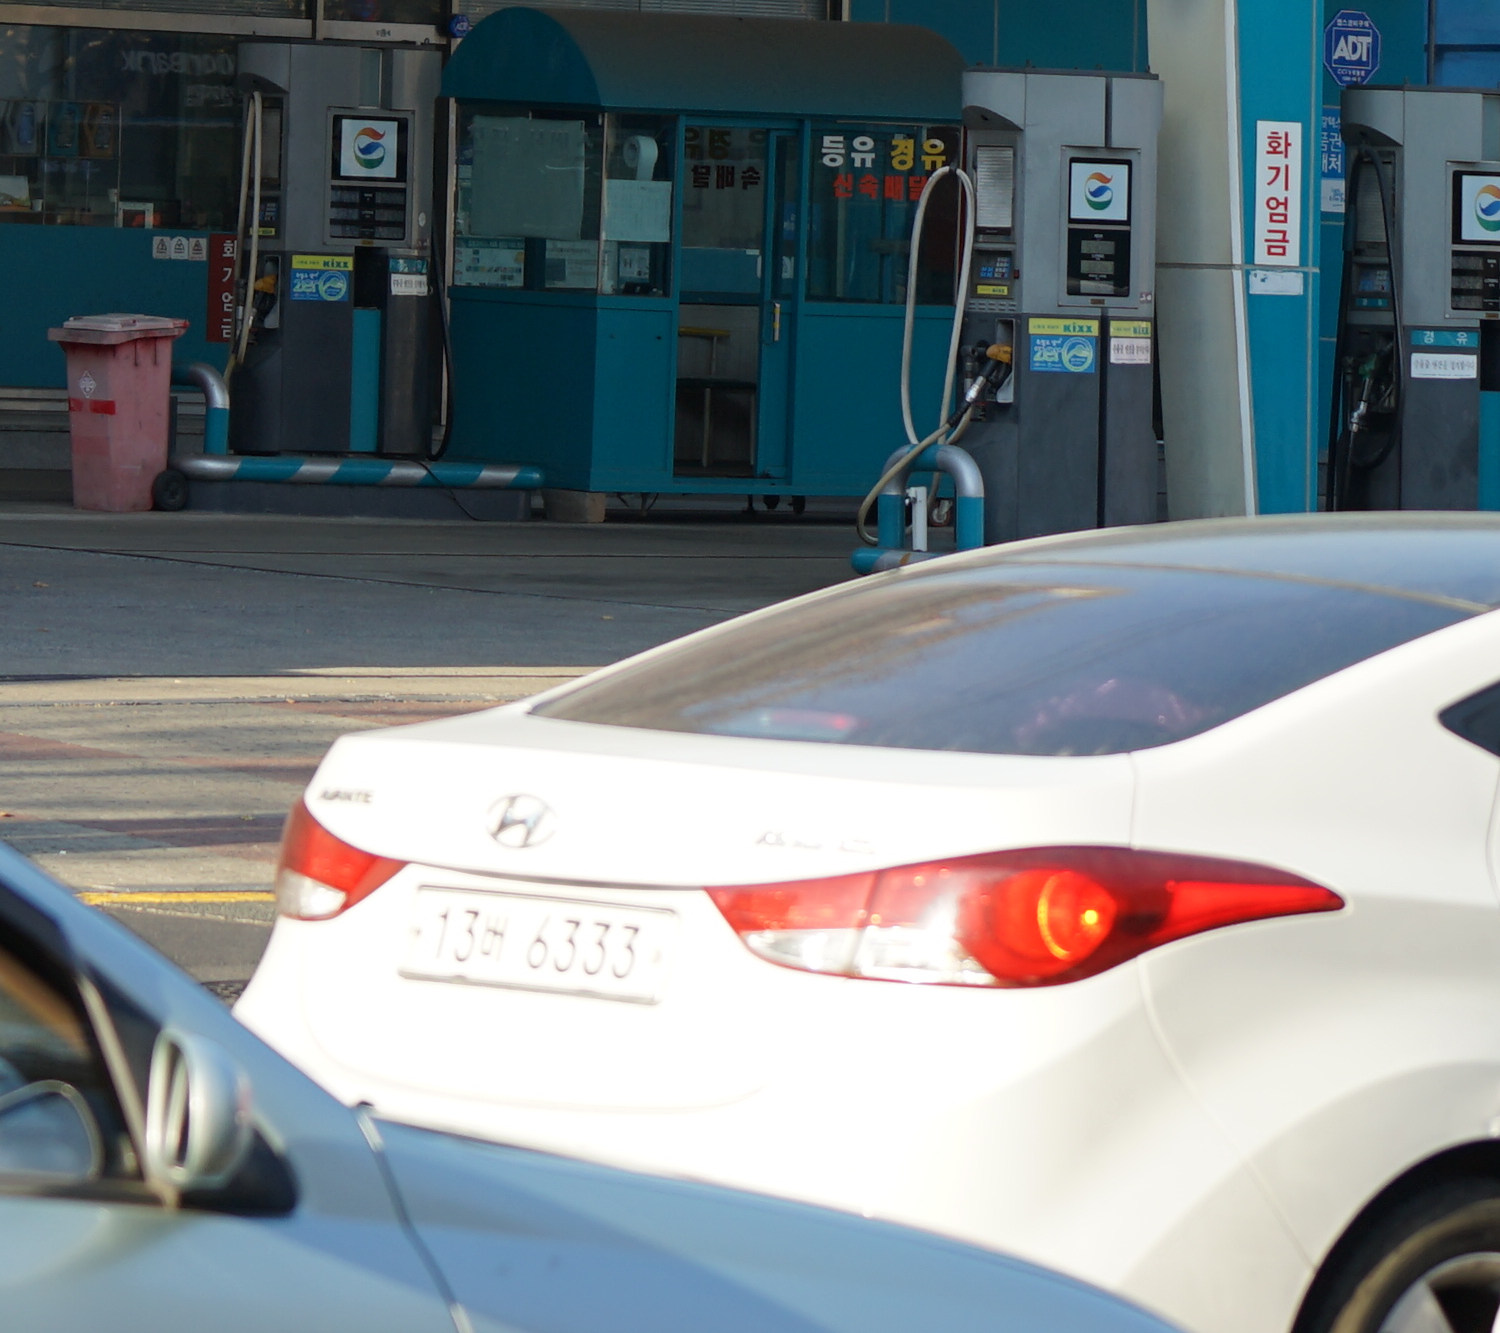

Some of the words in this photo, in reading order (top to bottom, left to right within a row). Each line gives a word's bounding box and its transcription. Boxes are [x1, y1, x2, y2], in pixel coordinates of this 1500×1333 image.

[1332, 34, 1373, 62] ADT
[820, 134, 876, 168] 등유
[889, 136, 948, 171] 경유
[1263, 130, 1292, 258] 화기엄금
[322, 258, 350, 269] Kixx
[1063, 324, 1093, 334] Kixx
[526, 914, 641, 980] 6333
